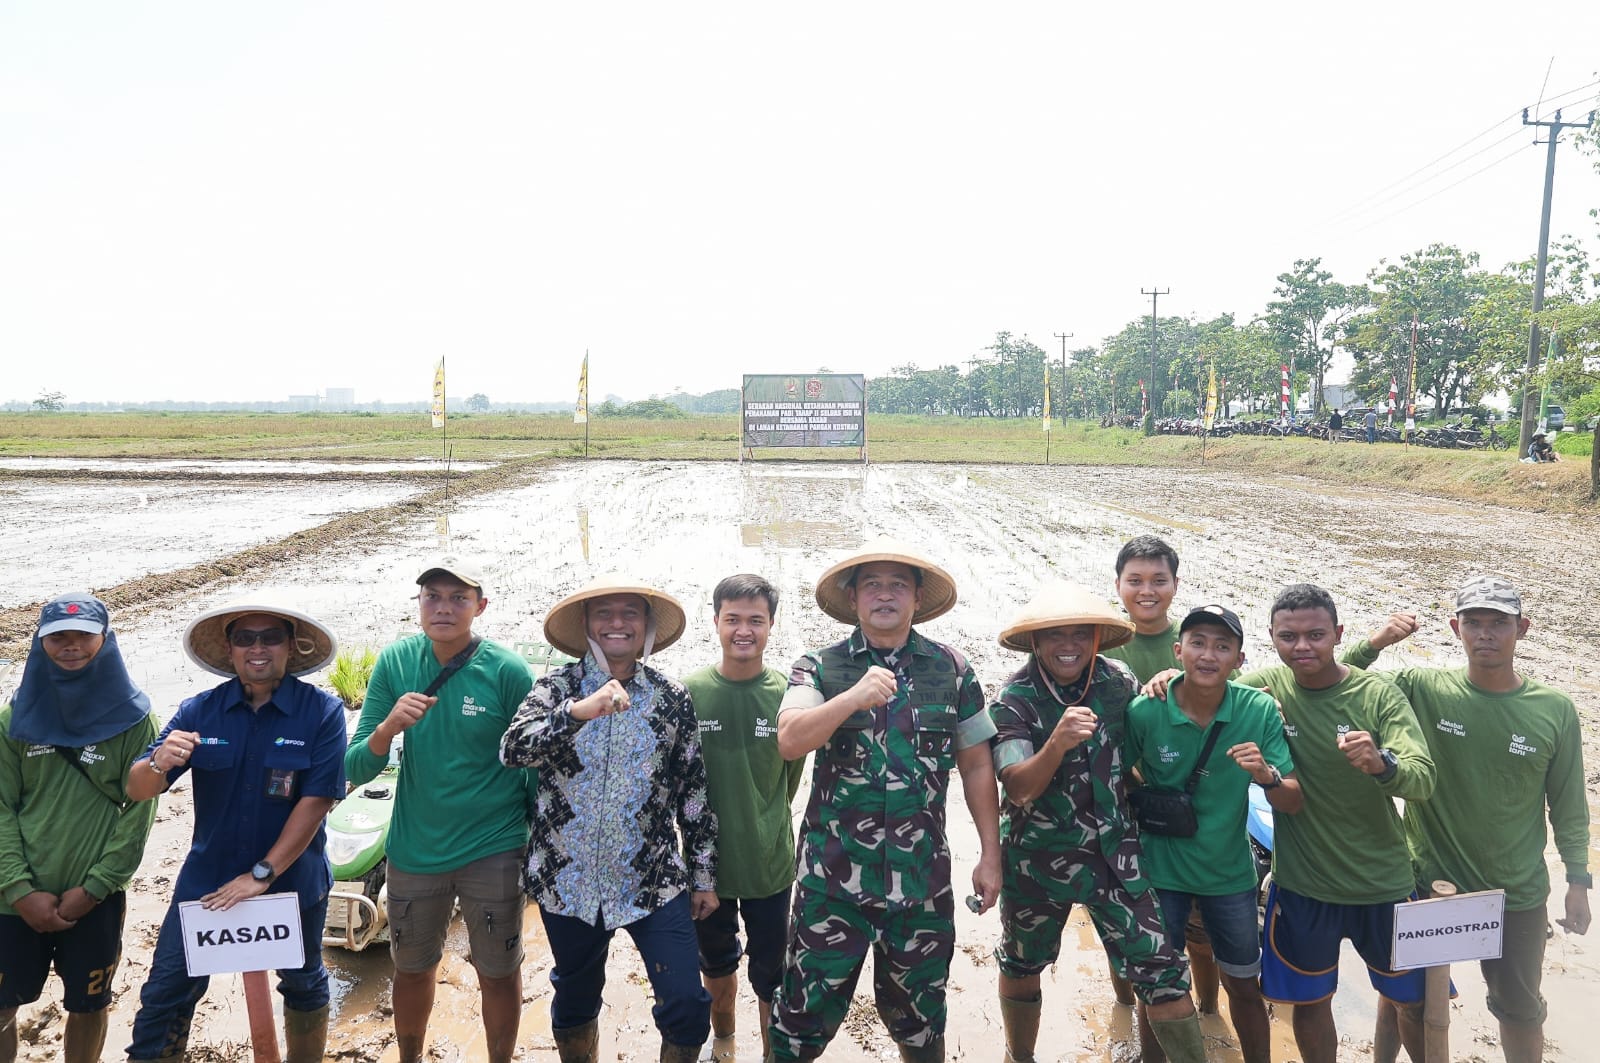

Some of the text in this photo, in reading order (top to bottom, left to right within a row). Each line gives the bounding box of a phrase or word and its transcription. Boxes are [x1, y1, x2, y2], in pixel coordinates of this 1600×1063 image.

[1440, 718, 1463, 730] Sahabat
[1509, 746, 1526, 756] tani
[1510, 742, 1536, 753] maxxi
[196, 924, 290, 947] KASAD
[1398, 921, 1499, 940] PANGKOSTRAD
